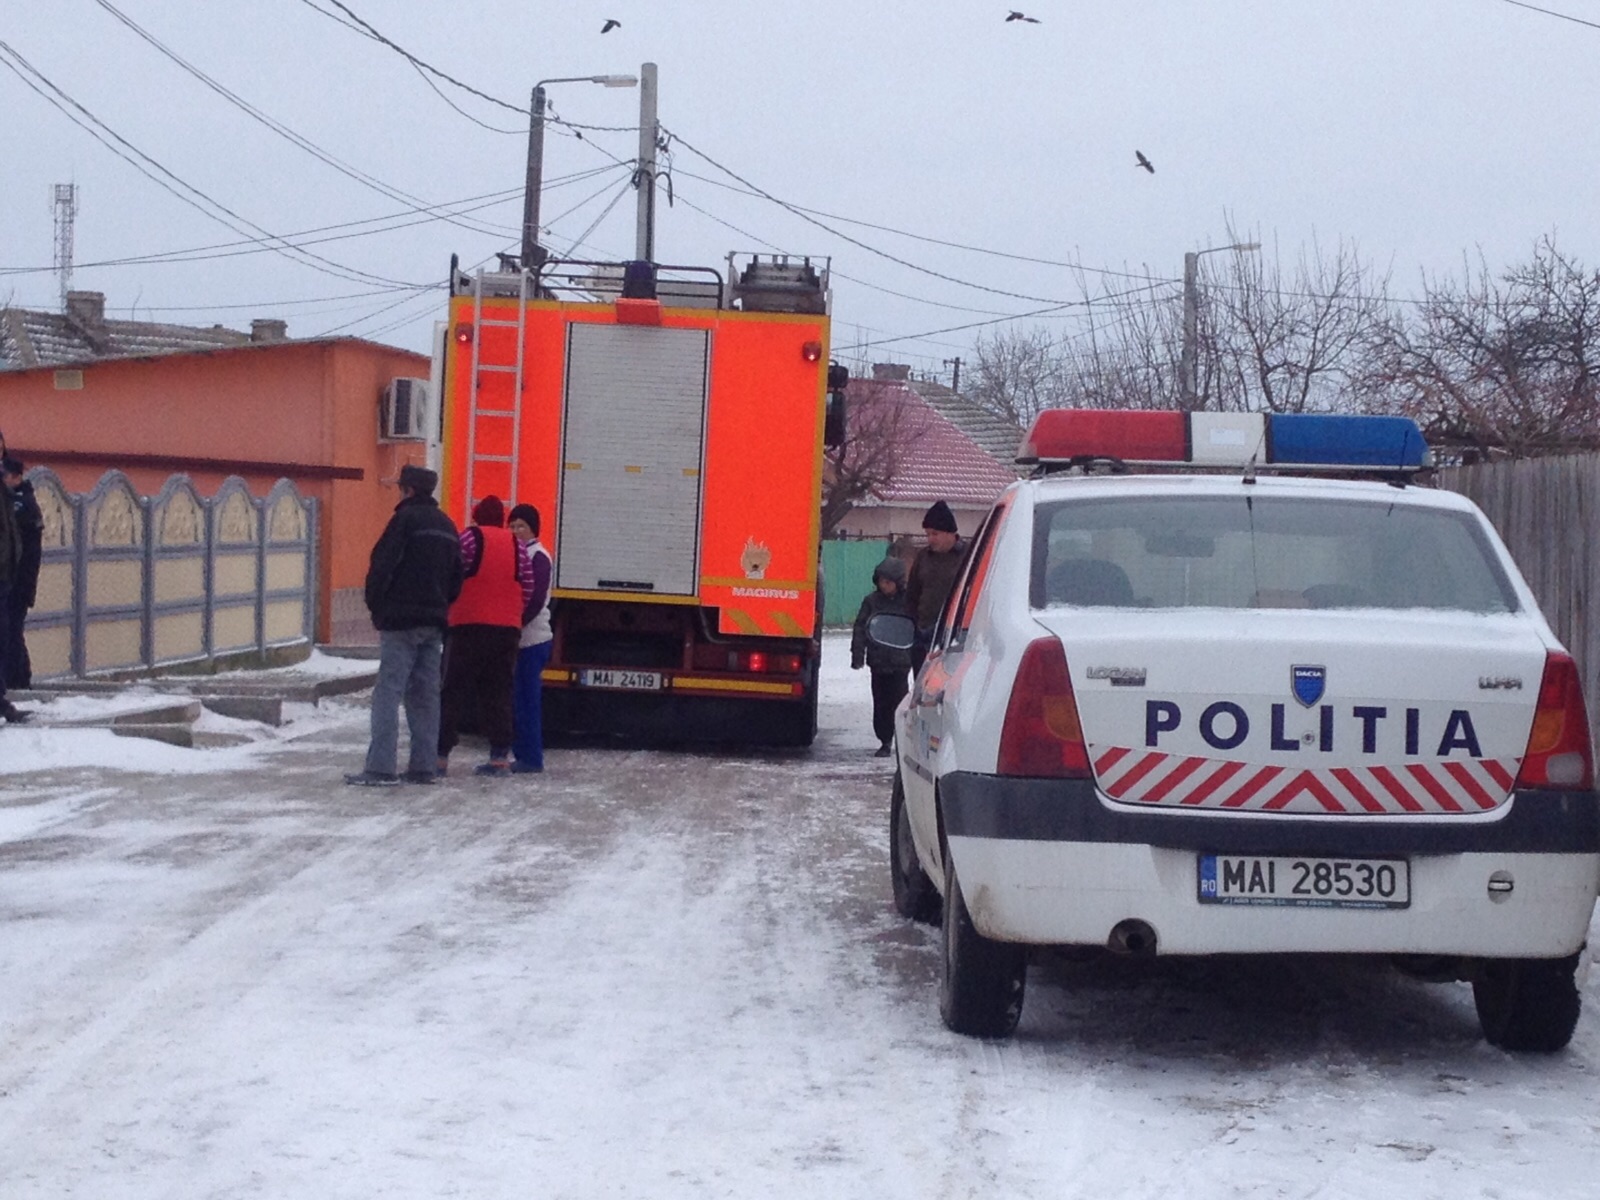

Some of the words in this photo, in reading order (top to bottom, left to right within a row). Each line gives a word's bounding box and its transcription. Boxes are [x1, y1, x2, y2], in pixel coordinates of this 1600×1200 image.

[732, 587, 799, 599] MAGIRUS
[593, 671, 614, 685] MAI
[620, 672, 654, 687] 24119
[1145, 700, 1483, 757] POLITIA
[1201, 879, 1216, 892] RO
[1223, 860, 1275, 893] MAI
[1292, 861, 1396, 897] 28530
